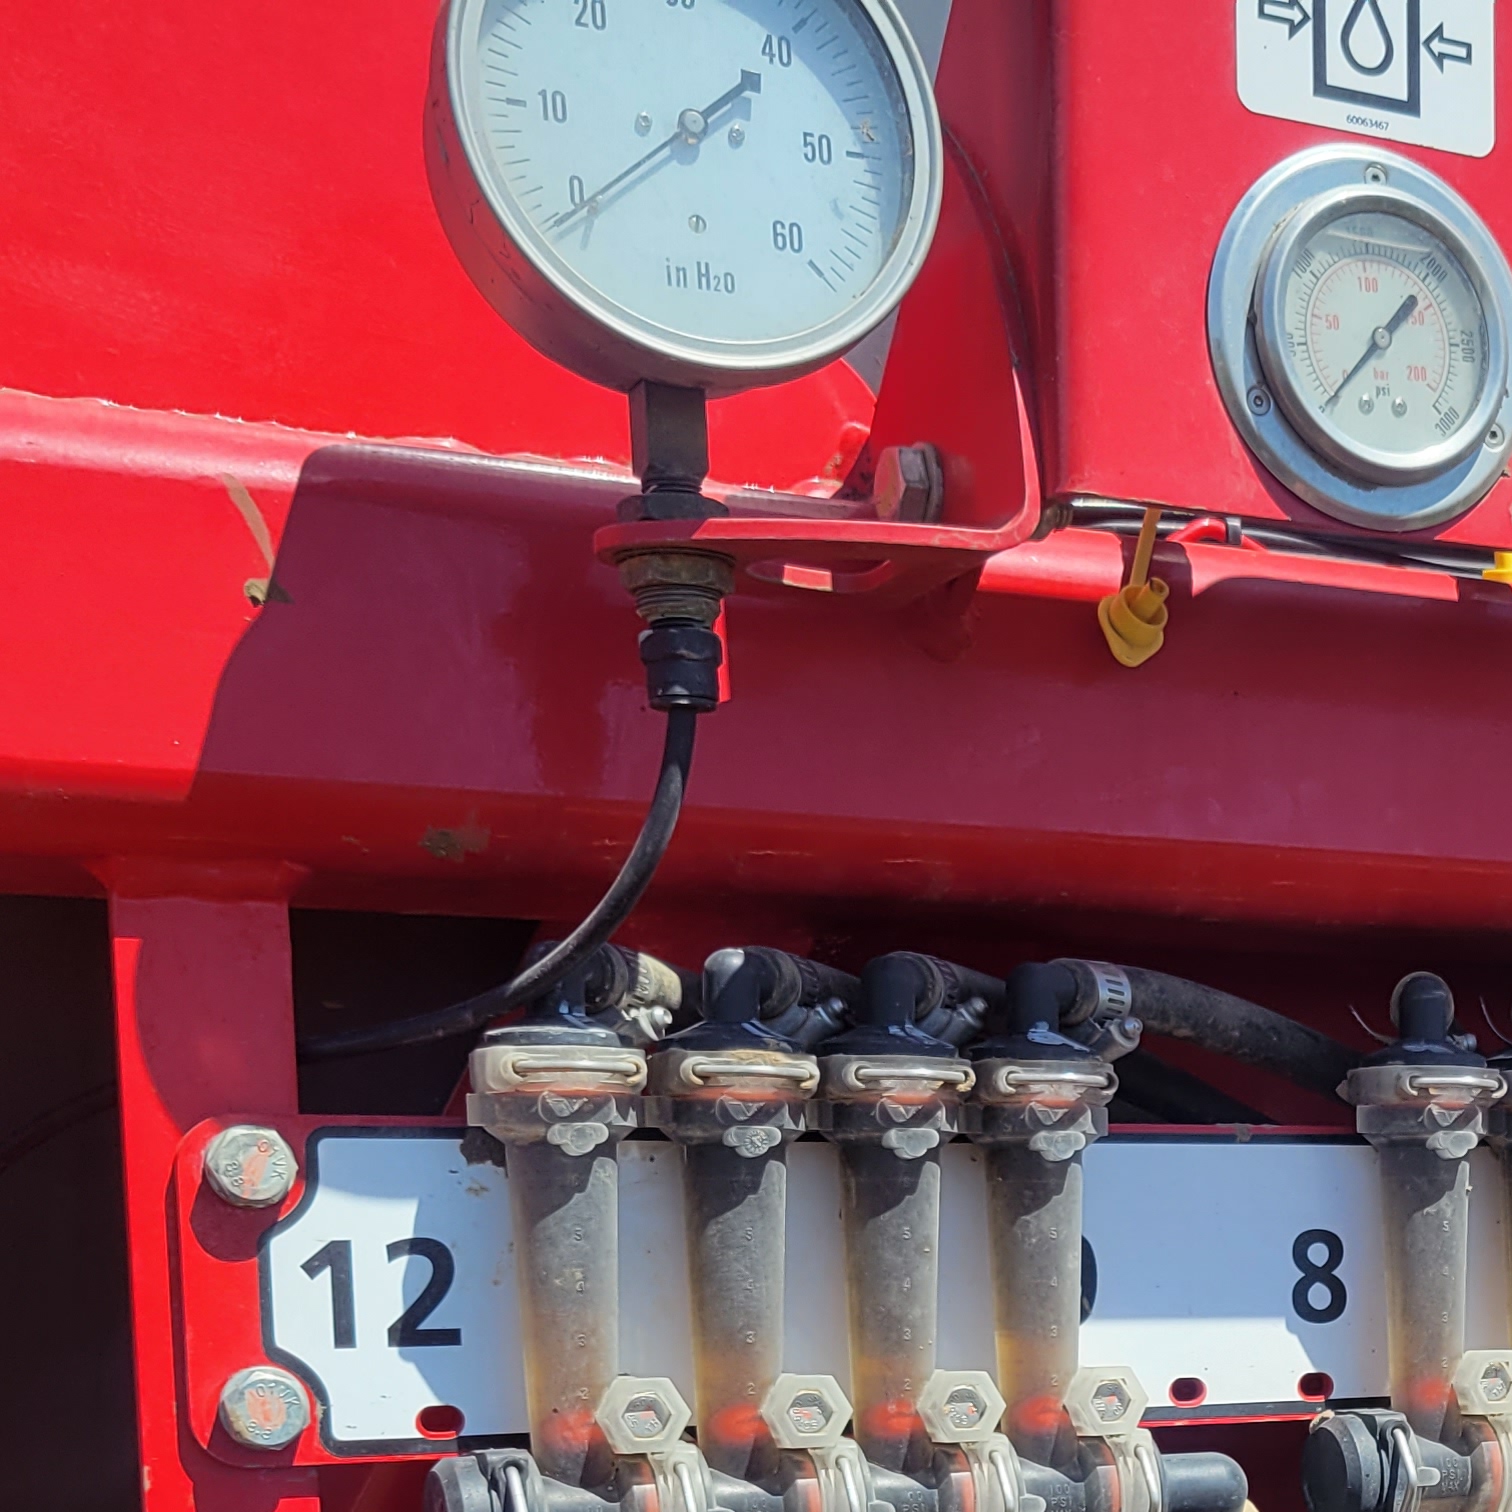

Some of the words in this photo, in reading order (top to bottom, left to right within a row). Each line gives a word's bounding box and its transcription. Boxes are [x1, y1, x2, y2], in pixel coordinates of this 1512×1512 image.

[761, 34, 792, 68] 40
[538, 88, 567, 123] 10
[803, 132, 832, 165] 50
[569, 175, 585, 205] 0
[772, 221, 803, 254] 60
[666, 258, 688, 288] in
[1419, 252, 1447, 284] 2000
[1357, 276, 1378, 293] 100
[1325, 314, 1339, 330] 50
[1460, 330, 1475, 363] 2500
[1373, 367, 1389, 381] bar
[1407, 365, 1427, 382] 200
[1375, 383, 1390, 399] psi
[1435, 406, 1460, 438] 3000
[1442, 1221, 1450, 1232] 5
[1291, 1228, 1348, 1325] 8
[299, 1236, 462, 1350] 12
[903, 1328, 912, 1340] 3
[1050, 1325, 1058, 1337] 3
[904, 1379, 912, 1391] 2
[1050, 1375, 1059, 1387] 2
